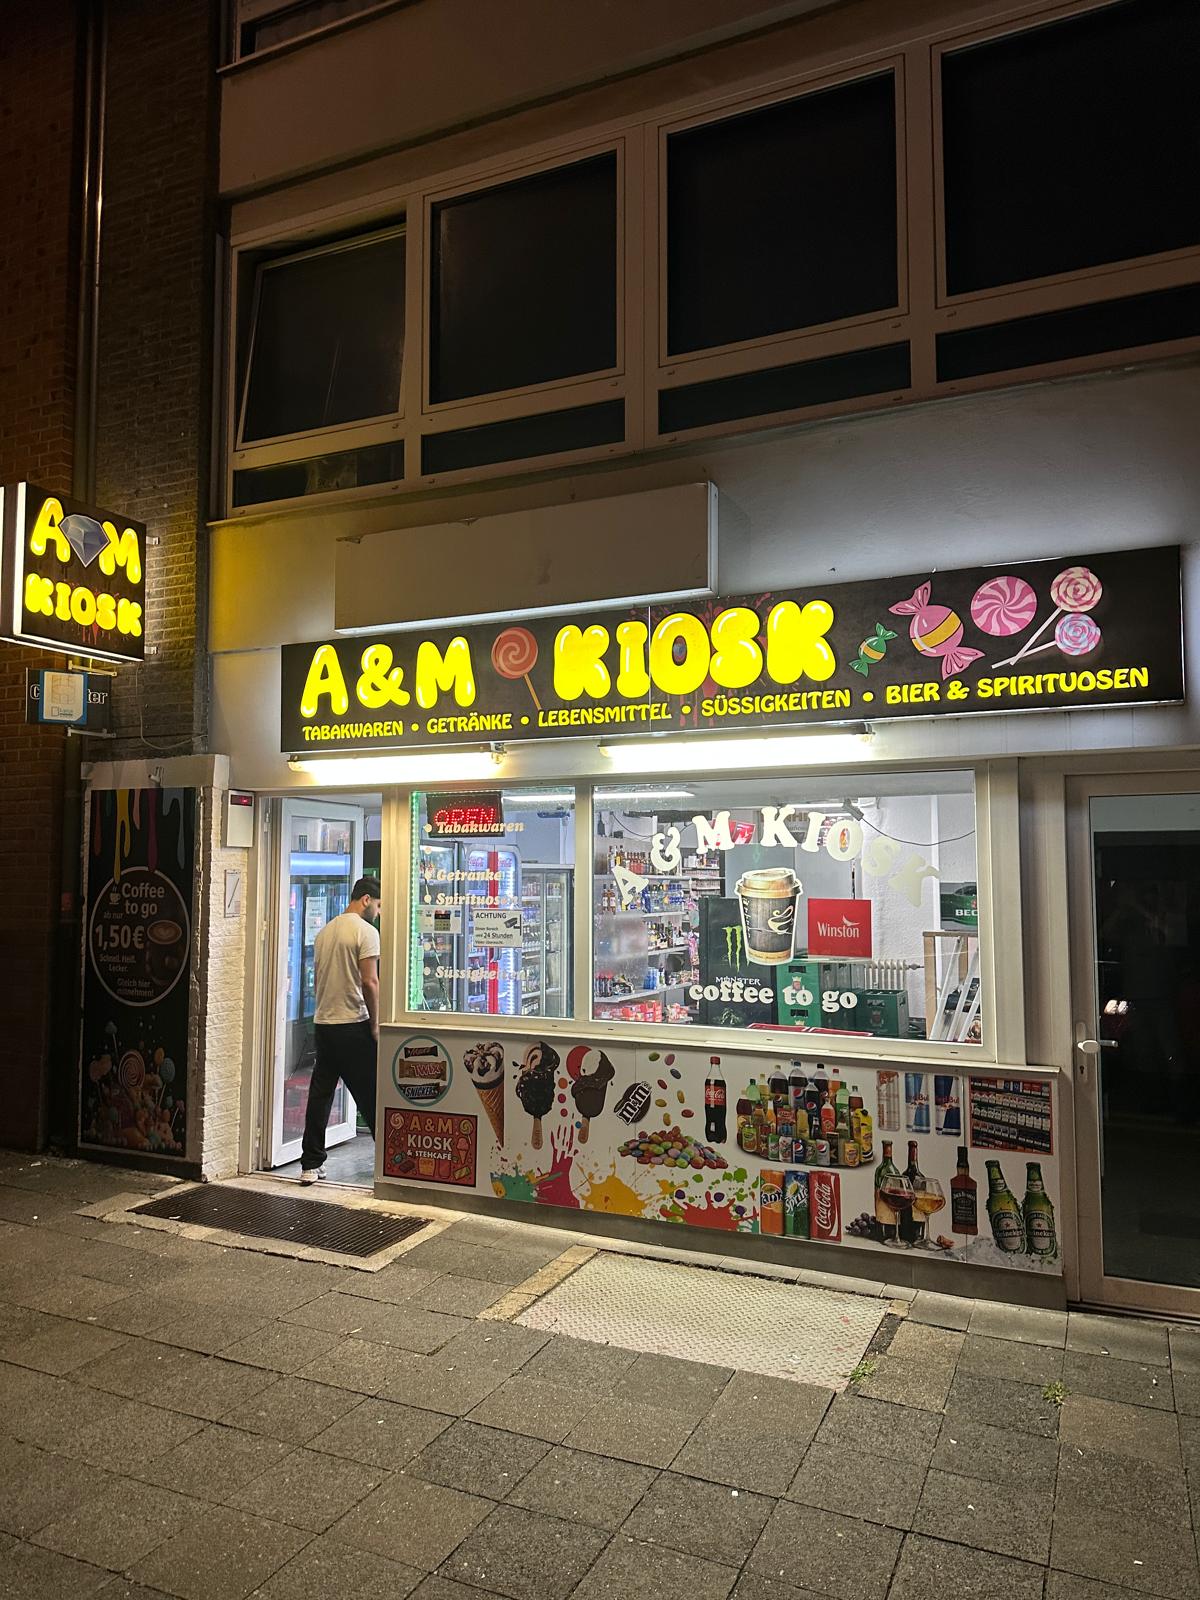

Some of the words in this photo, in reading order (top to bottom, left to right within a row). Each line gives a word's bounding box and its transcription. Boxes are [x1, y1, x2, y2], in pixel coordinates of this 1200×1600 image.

[31, 497, 71, 562] A
[99, 521, 142, 584] M
[25, 573, 142, 637] KIOSK
[553, 599, 836, 701] KIOSK
[302, 720, 404, 741] TABAKWAREN
[427, 711, 513, 734] GETRÄNKE
[538, 702, 672, 728] LEBENSMITTEL
[701, 688, 852, 717] SÜSSIGKEITEN
[886, 682, 940, 706] BIER
[946, 680, 970, 701] &
[977, 667, 1150, 699] SPIRITUOSEN
[434, 807, 496, 824] OPEN
[436, 820, 525, 834] Tabakwaren
[760, 804, 941, 908] KIOSK
[437, 868, 502, 881] Getränke
[121, 882, 165, 898] Coffee
[125, 901, 139, 915] to
[141, 903, 158, 919] go
[95, 924, 145, 951] 1,50€
[817, 921, 860, 938] Winston
[689, 981, 774, 1004] coffee
[782, 988, 814, 1006] to
[821, 990, 858, 1013] go
[410, 1063, 441, 1077] TWIX
[407, 1133, 453, 1151] KIOSK
[415, 1150, 452, 1161] STEHCAFÉ
[785, 1185, 809, 1213] Sprite
